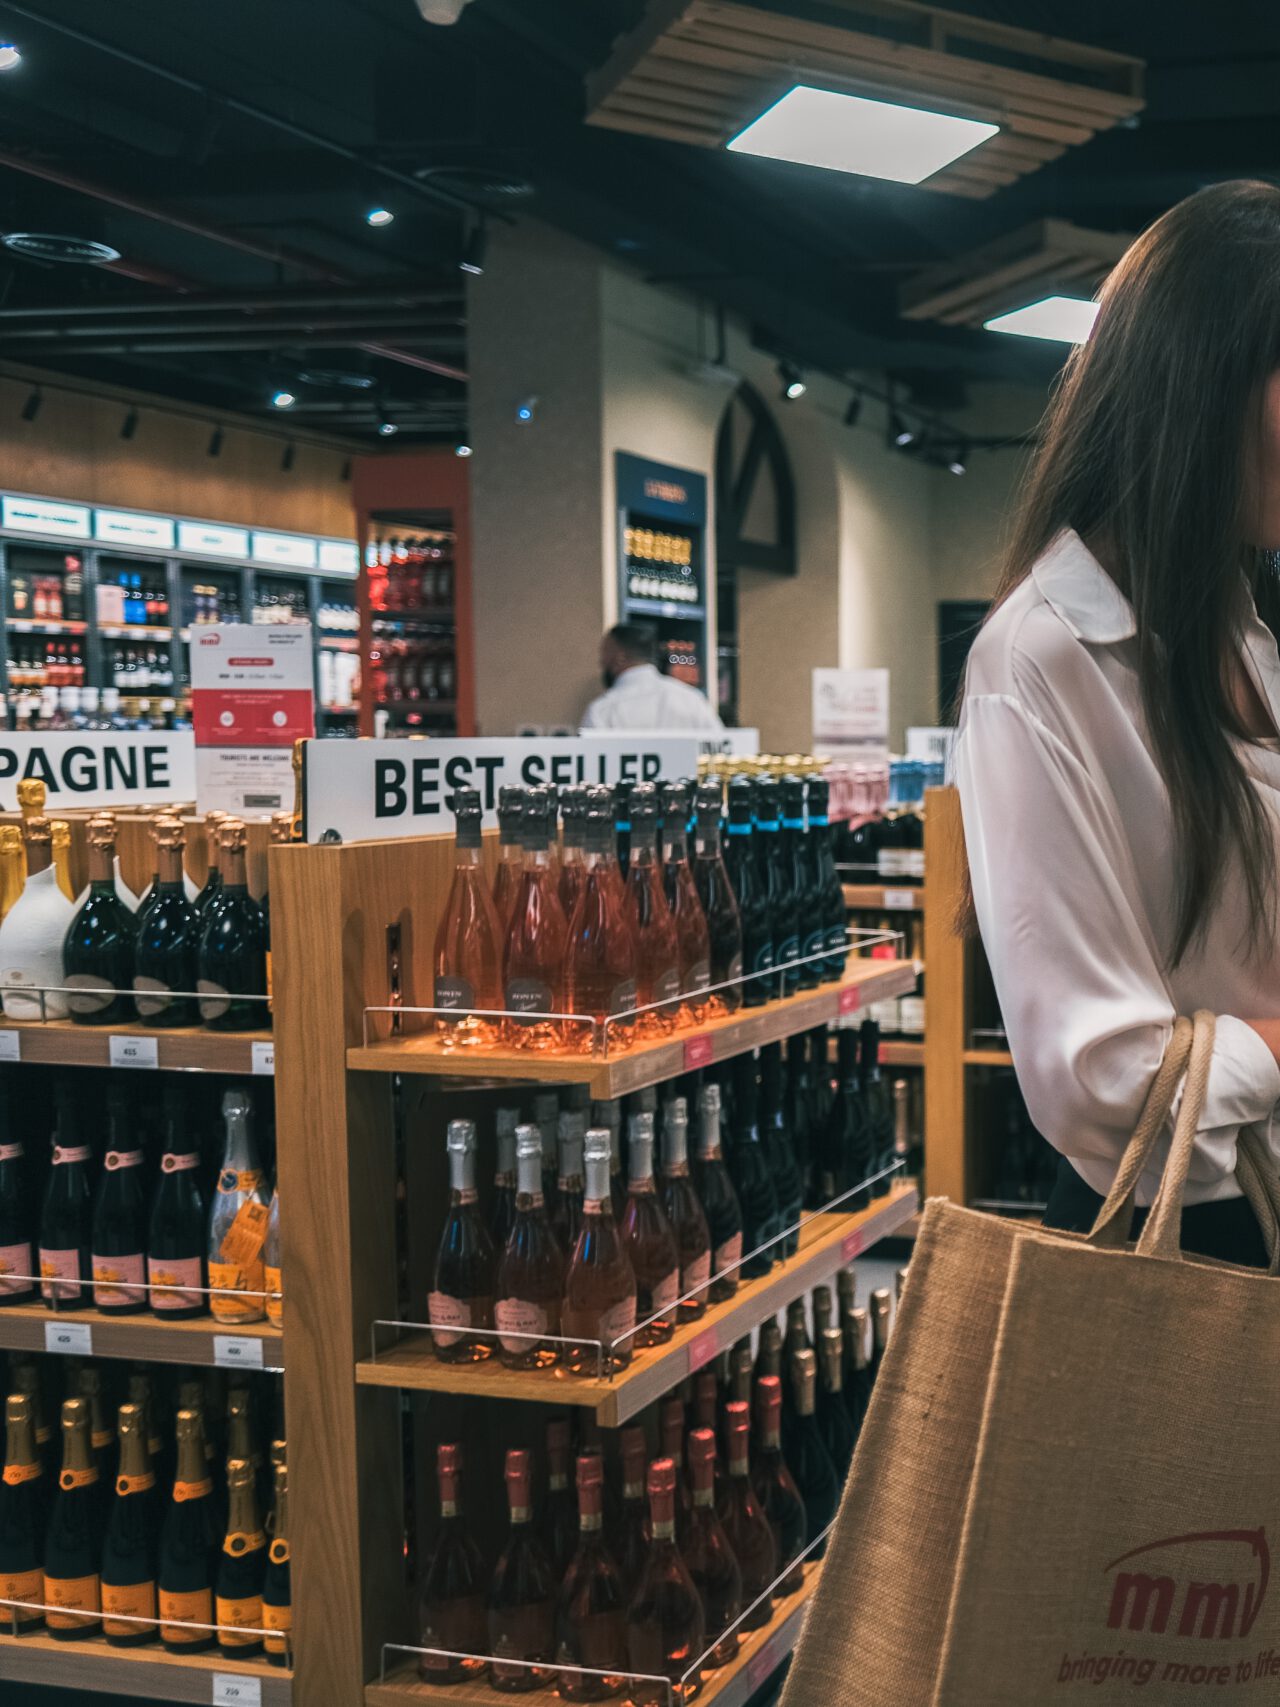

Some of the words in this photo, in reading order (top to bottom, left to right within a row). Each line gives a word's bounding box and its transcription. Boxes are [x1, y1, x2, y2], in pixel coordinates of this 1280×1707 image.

[375, 756, 504, 818] BEST
[1057, 1651, 1157, 1686] bringing
[1161, 1661, 1231, 1685] more
[1235, 1659, 1252, 1685] to
